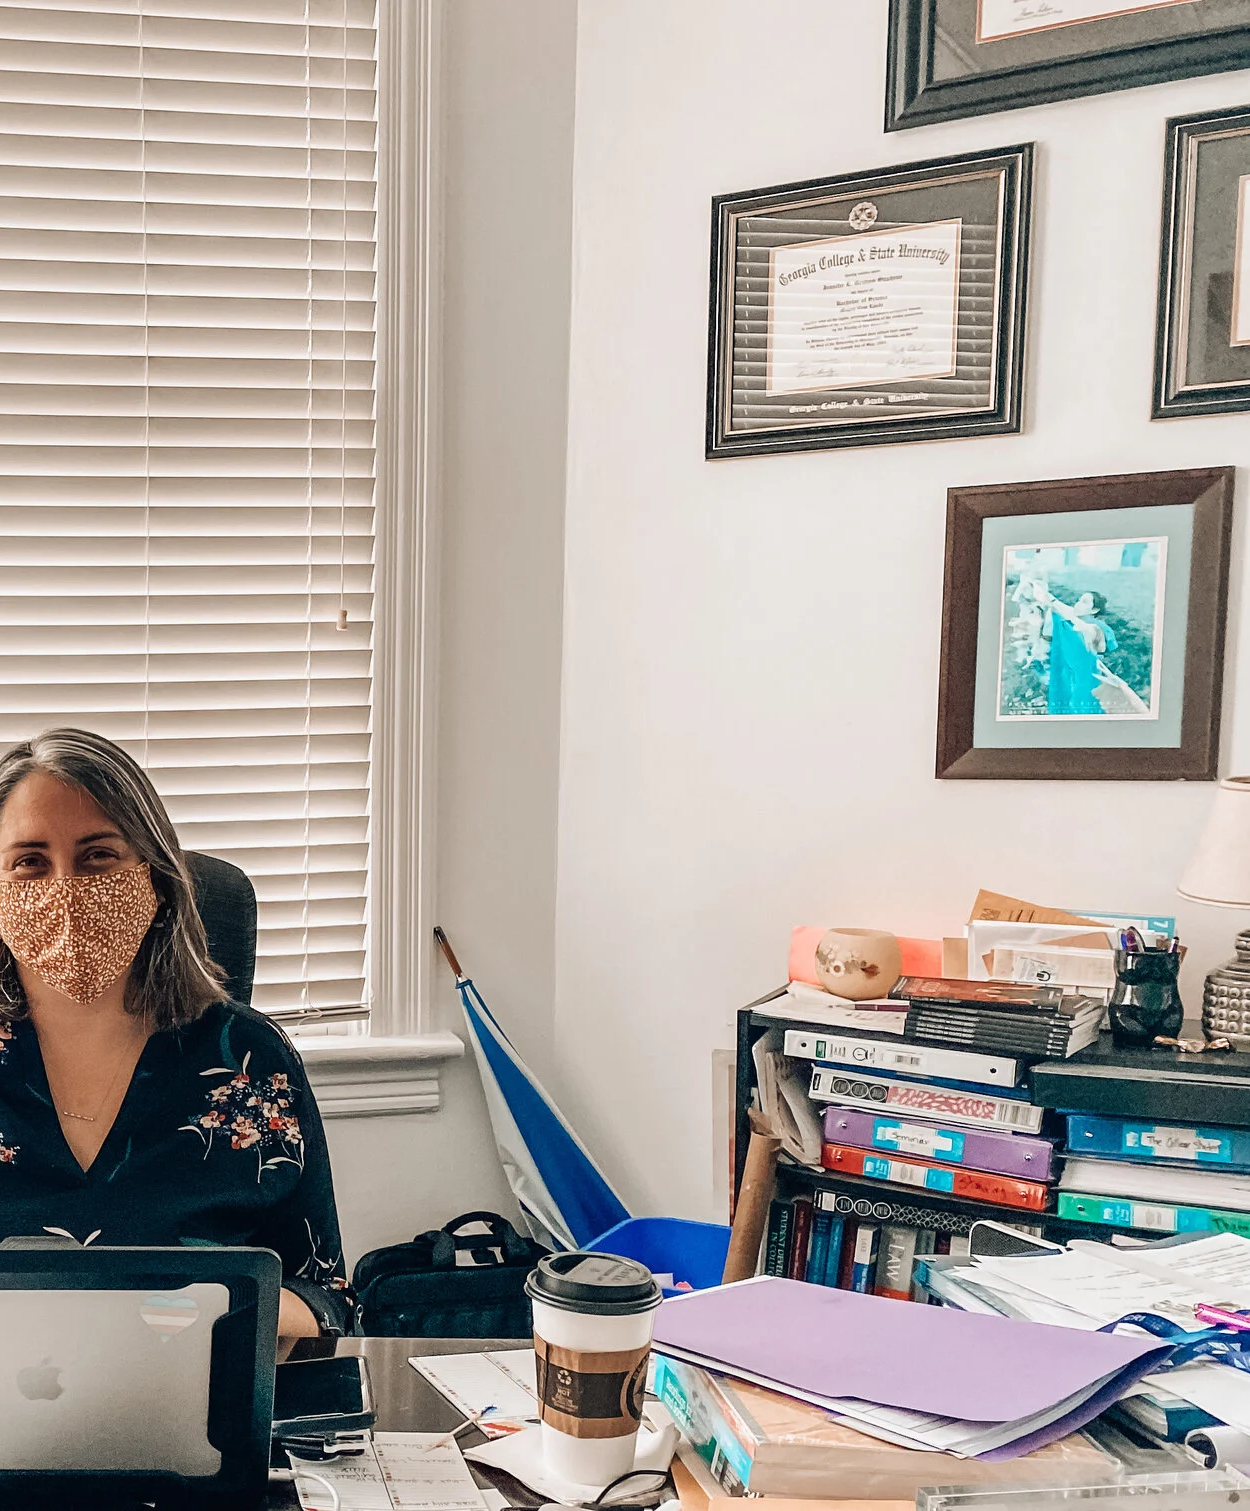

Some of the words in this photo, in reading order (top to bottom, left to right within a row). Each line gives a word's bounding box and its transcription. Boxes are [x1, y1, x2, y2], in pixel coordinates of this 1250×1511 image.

[778, 262, 817, 287] Georgia
[818, 252, 854, 270] College
[857, 248, 866, 262] &
[869, 246, 896, 260] State
[898, 243, 951, 265] University
[788, 404, 818, 414] Georgia
[820, 400, 849, 411] College
[863, 396, 885, 406] State
[888, 391, 930, 403] University
[777, 1209, 789, 1248] STUDENT
[886, 1243, 906, 1283] LAW
